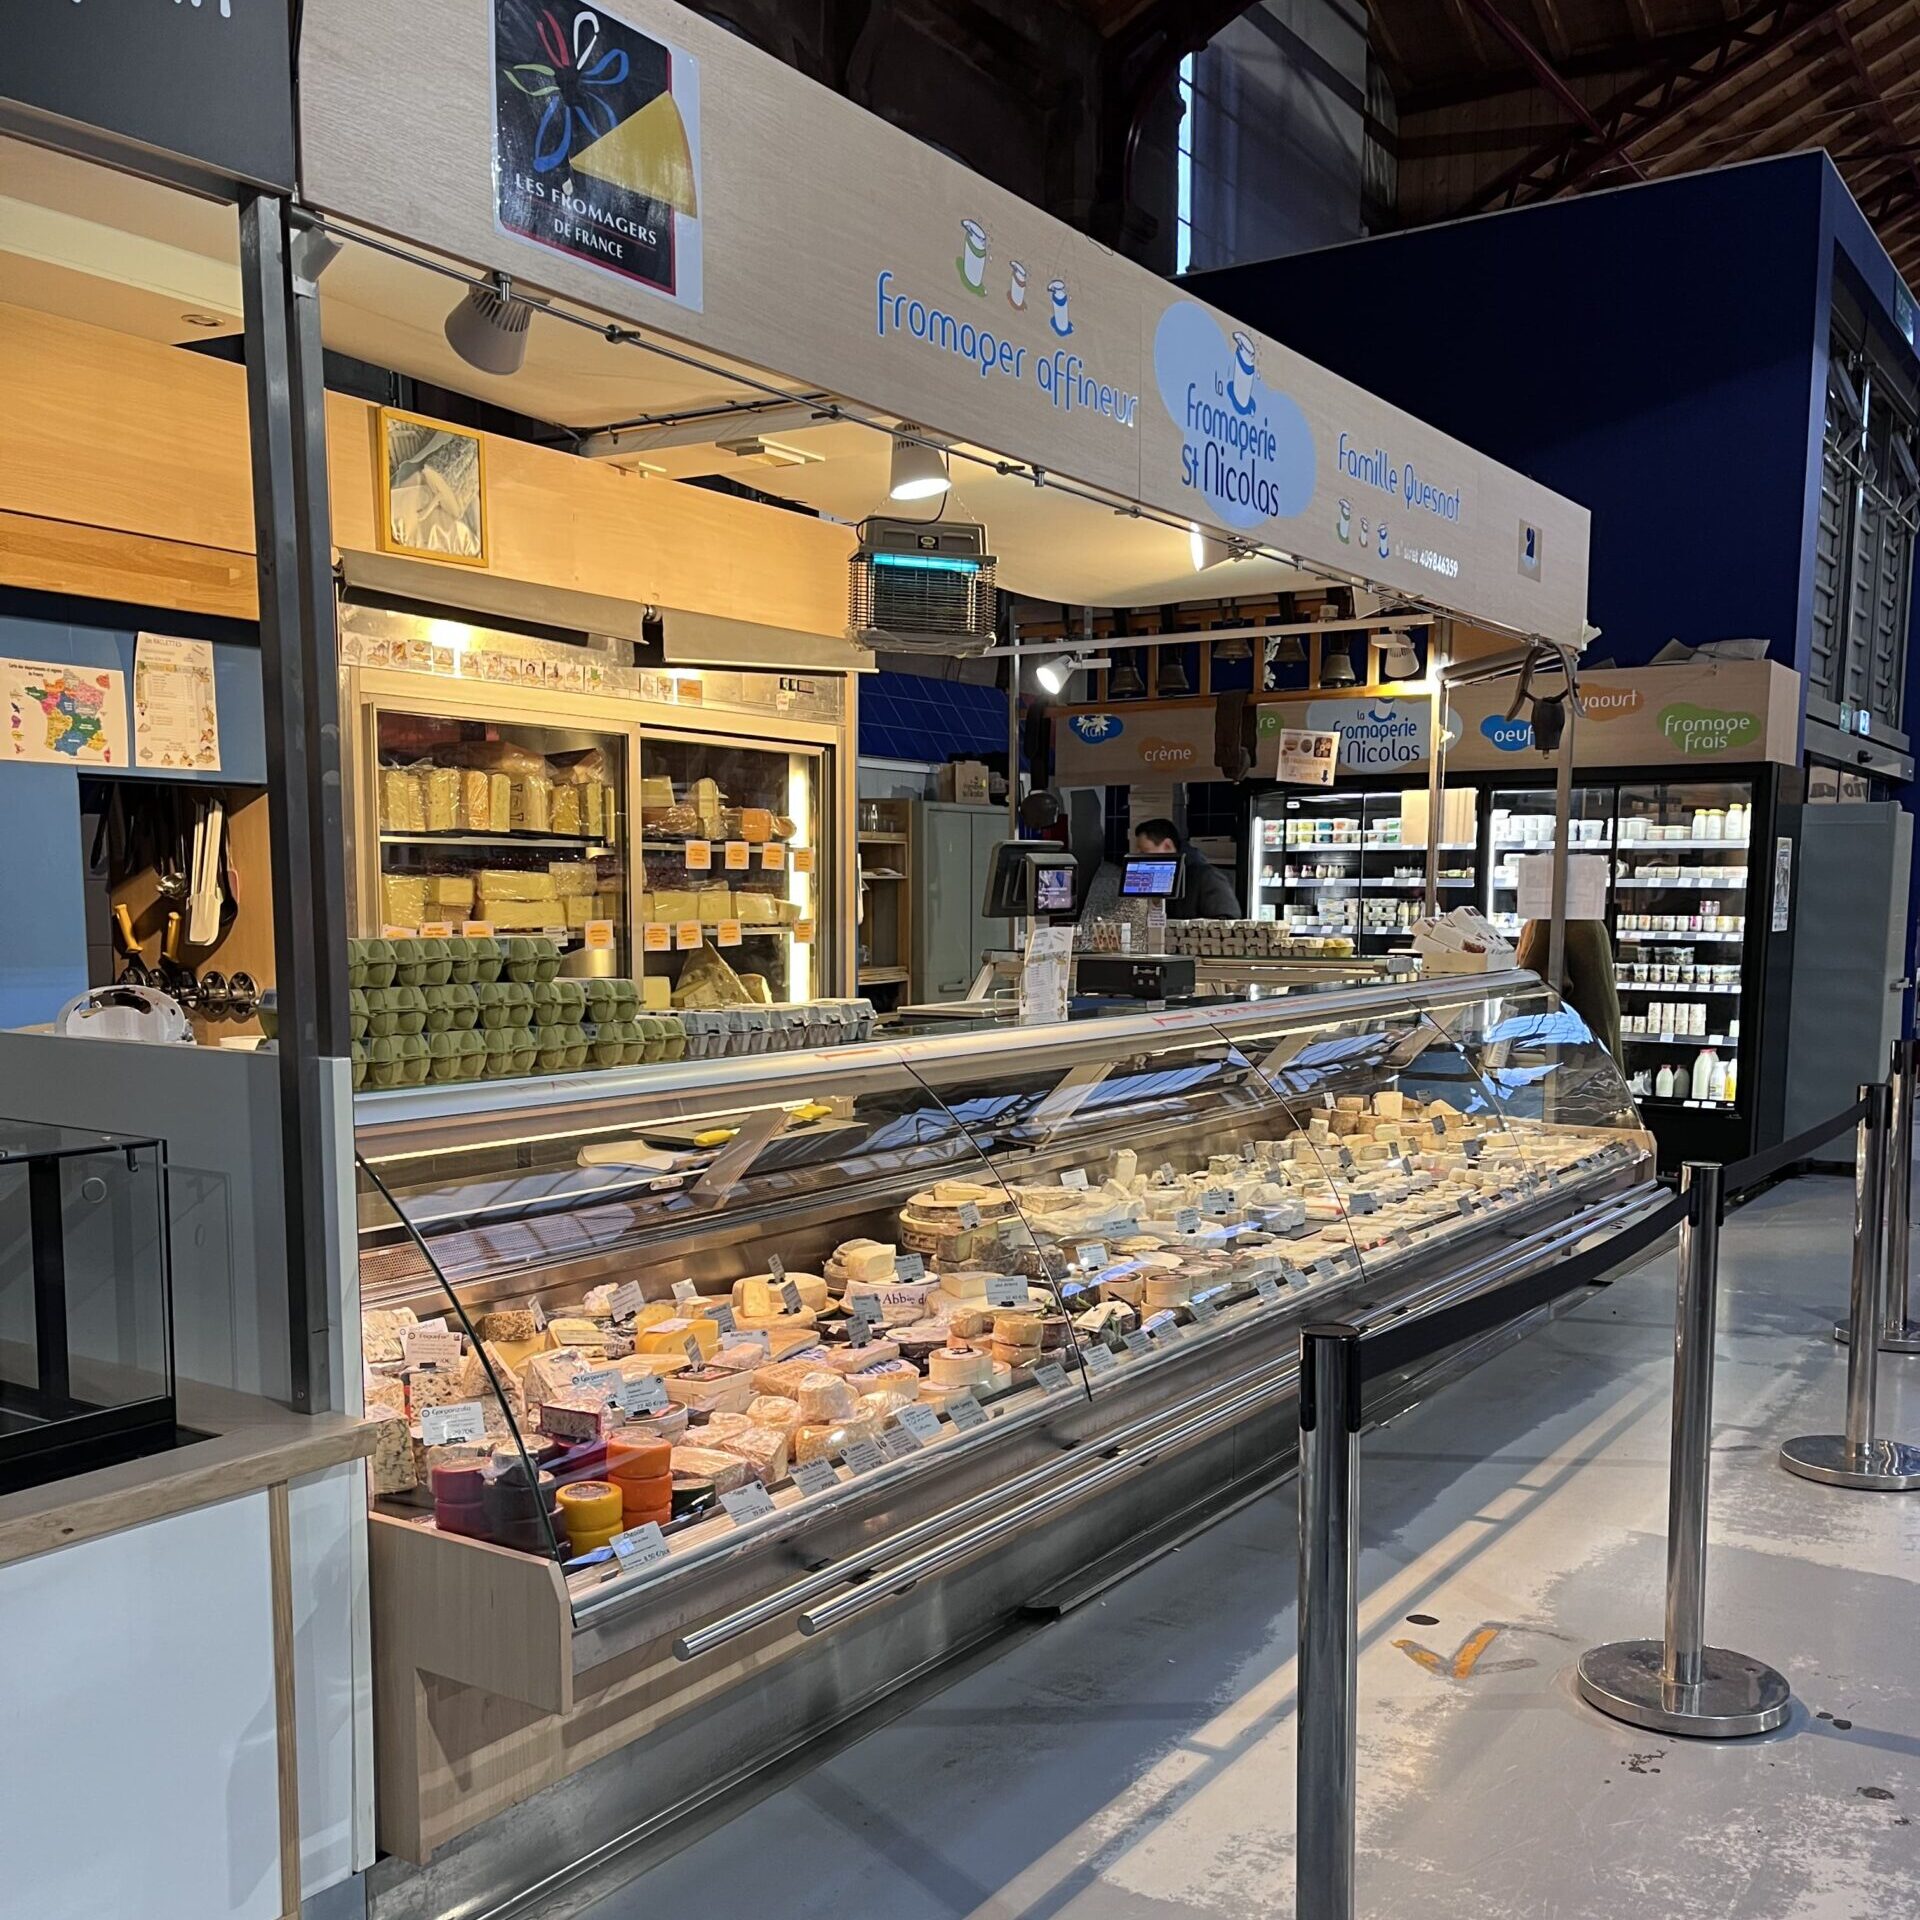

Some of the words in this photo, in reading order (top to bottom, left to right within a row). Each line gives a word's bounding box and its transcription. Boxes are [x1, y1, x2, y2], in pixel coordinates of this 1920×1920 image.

[516, 173, 545, 198] LES
[552, 188, 657, 246] FROMAGERS
[554, 218, 571, 238] DE
[575, 227, 624, 259] FRANCE
[877, 270, 1027, 378] fromager
[1037, 350, 1138, 428] affineur
[1214, 371, 1224, 397] la
[1187, 382, 1277, 462] fromagerie
[1181, 443, 1200, 489] St
[1204, 441, 1280, 518] Nicolas
[1338, 432, 1398, 495] Famille
[1403, 463, 1461, 524] Quesnot
[1356, 709, 1366, 721] la
[1664, 714, 1751, 737] fromage
[1332, 717, 1418, 743] fromagerie
[1684, 731, 1729, 753] frais
[1143, 744, 1193, 763] crème
[1347, 738, 1421, 765] Nicolas
[431, 1404, 472, 1417] Gorgonzola
